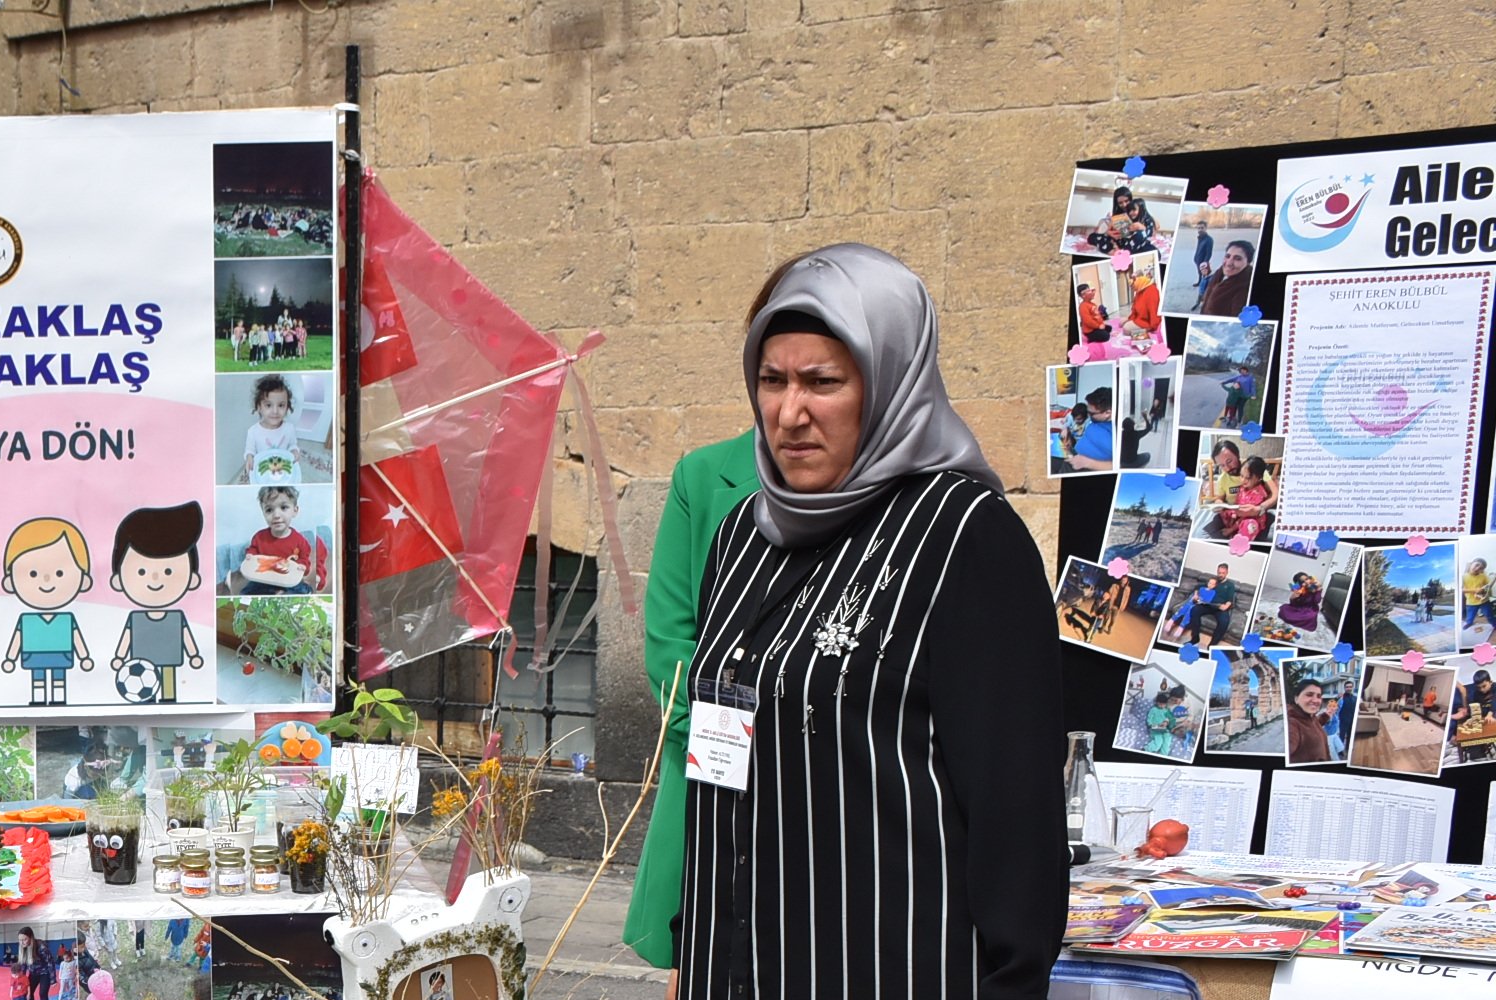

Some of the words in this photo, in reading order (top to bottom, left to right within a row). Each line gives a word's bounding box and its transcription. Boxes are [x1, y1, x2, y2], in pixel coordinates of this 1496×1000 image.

[1389, 162, 1494, 206] Aile
[1385, 213, 1496, 259] Gelec
[1329, 289, 1363, 302] ŞEHİT
[1365, 288, 1397, 299] EREN
[1399, 286, 1448, 298] BÜLBÜL
[1353, 299, 1421, 312] ANAOKULU
[41, 421, 136, 461] DÖN!
